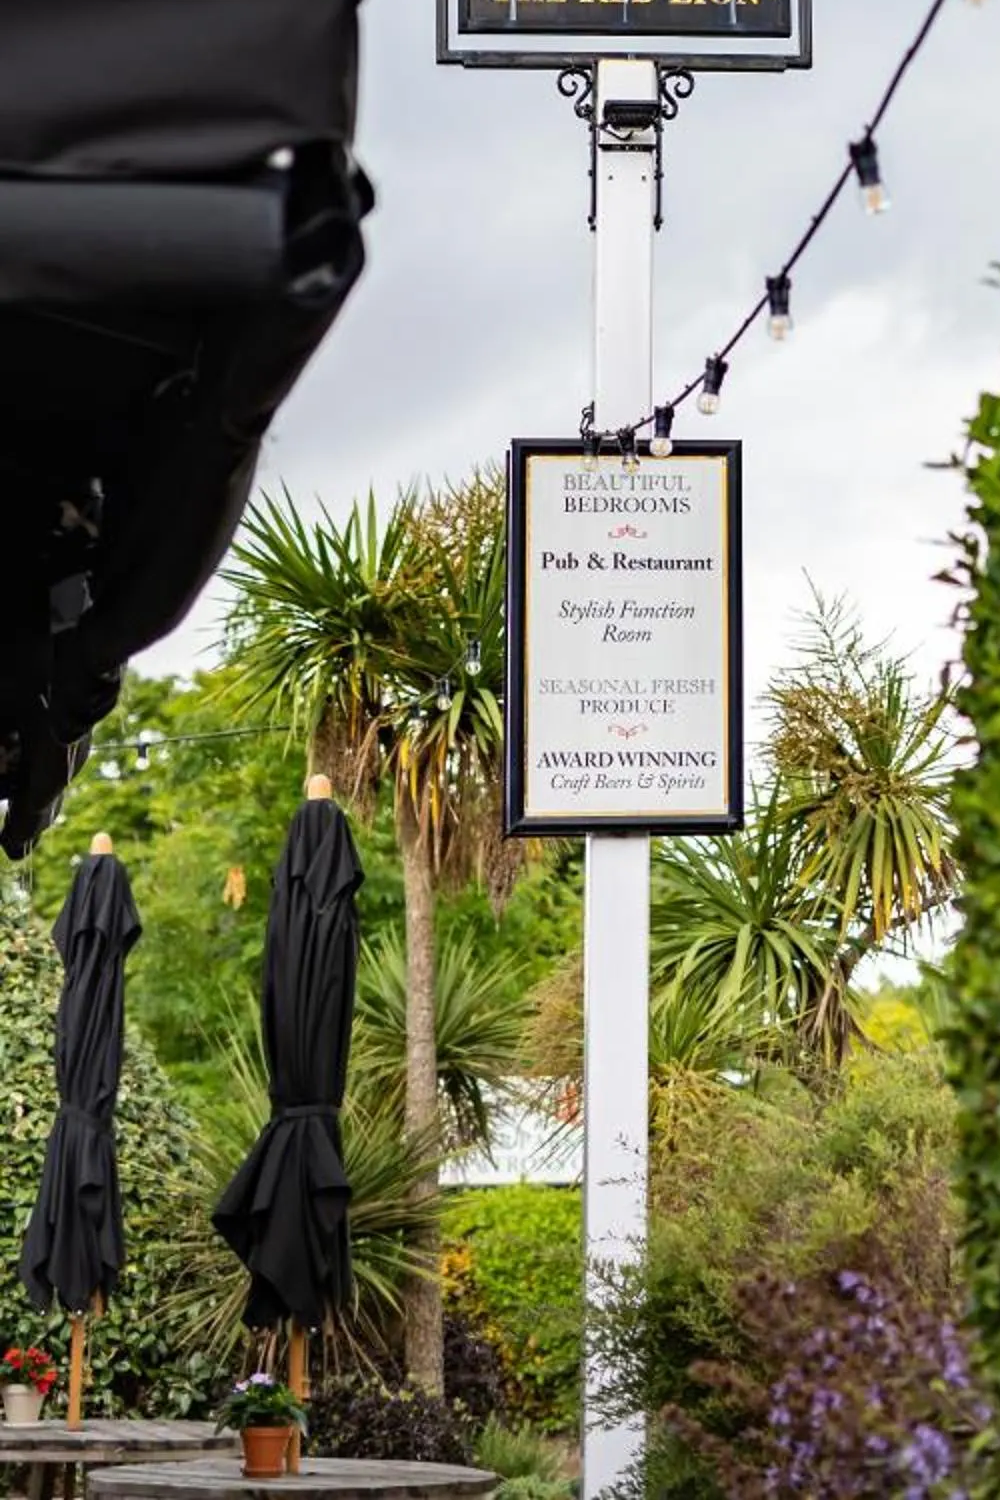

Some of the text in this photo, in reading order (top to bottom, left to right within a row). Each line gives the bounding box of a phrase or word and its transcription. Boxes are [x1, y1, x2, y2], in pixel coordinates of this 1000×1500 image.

[564, 474, 691, 491] BEAUTIFUL
[564, 496, 691, 513] BEDROOMS
[541, 552, 714, 571] Pub & Restaurant
[559, 600, 696, 625] Stylish Function
[602, 623, 652, 643] Room
[539, 679, 716, 695] SEASONAL FRESH
[580, 699, 676, 715] PRODUCE
[537, 751, 717, 768] AWARD WINNING
[551, 773, 706, 794] Craft Beers & Spirits
